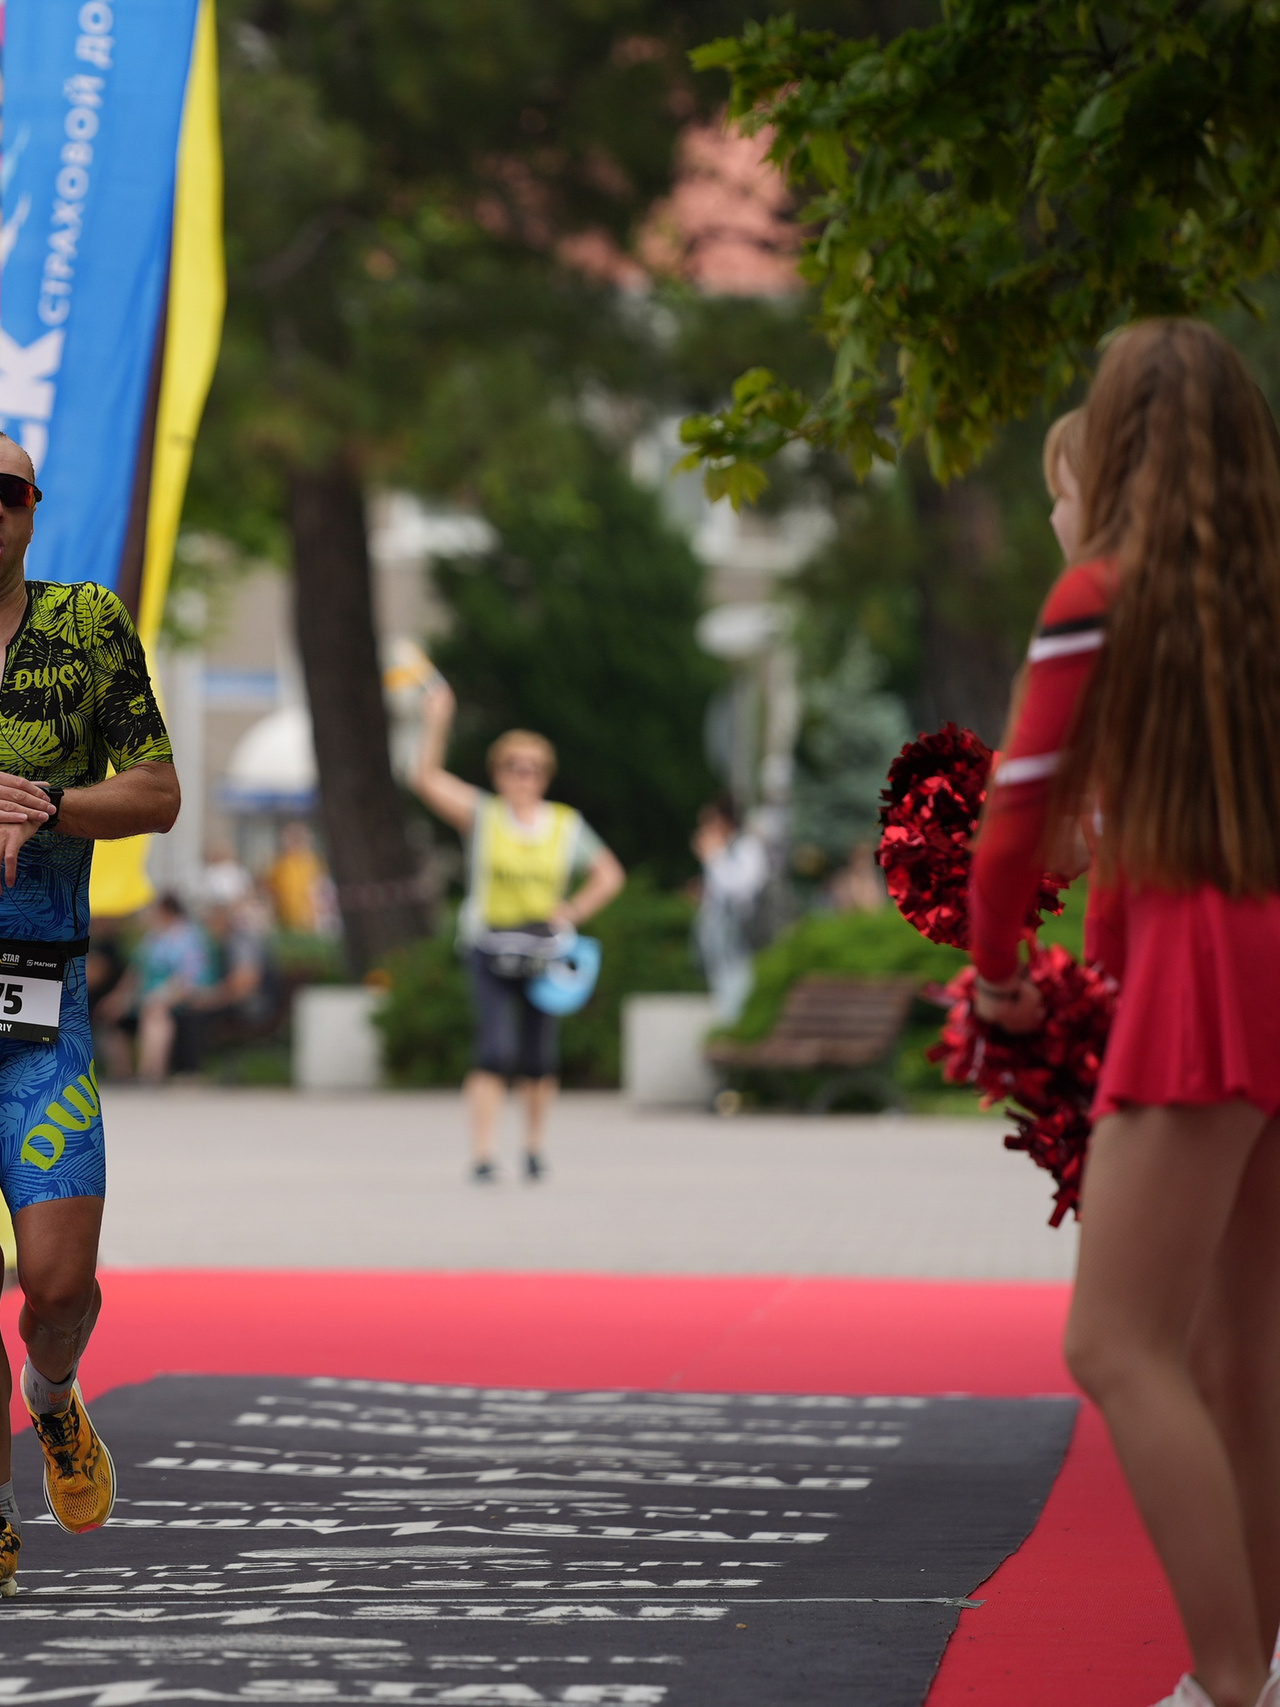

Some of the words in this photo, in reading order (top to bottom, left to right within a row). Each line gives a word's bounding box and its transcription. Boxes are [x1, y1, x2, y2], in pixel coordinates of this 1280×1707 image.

[37, 73, 106, 326] СТРАХОВОЙ
[1, 953, 20, 963] STAR
[33, 960, 57, 969] МАГНИТ
[145, 1457, 428, 1478] IRON
[576, 1470, 873, 1489] STAR
[503, 1522, 830, 1541] STAR
[405, 1579, 763, 1588] STAR
[351, 1605, 732, 1617] STAR
[238, 1679, 669, 1704] STAR
